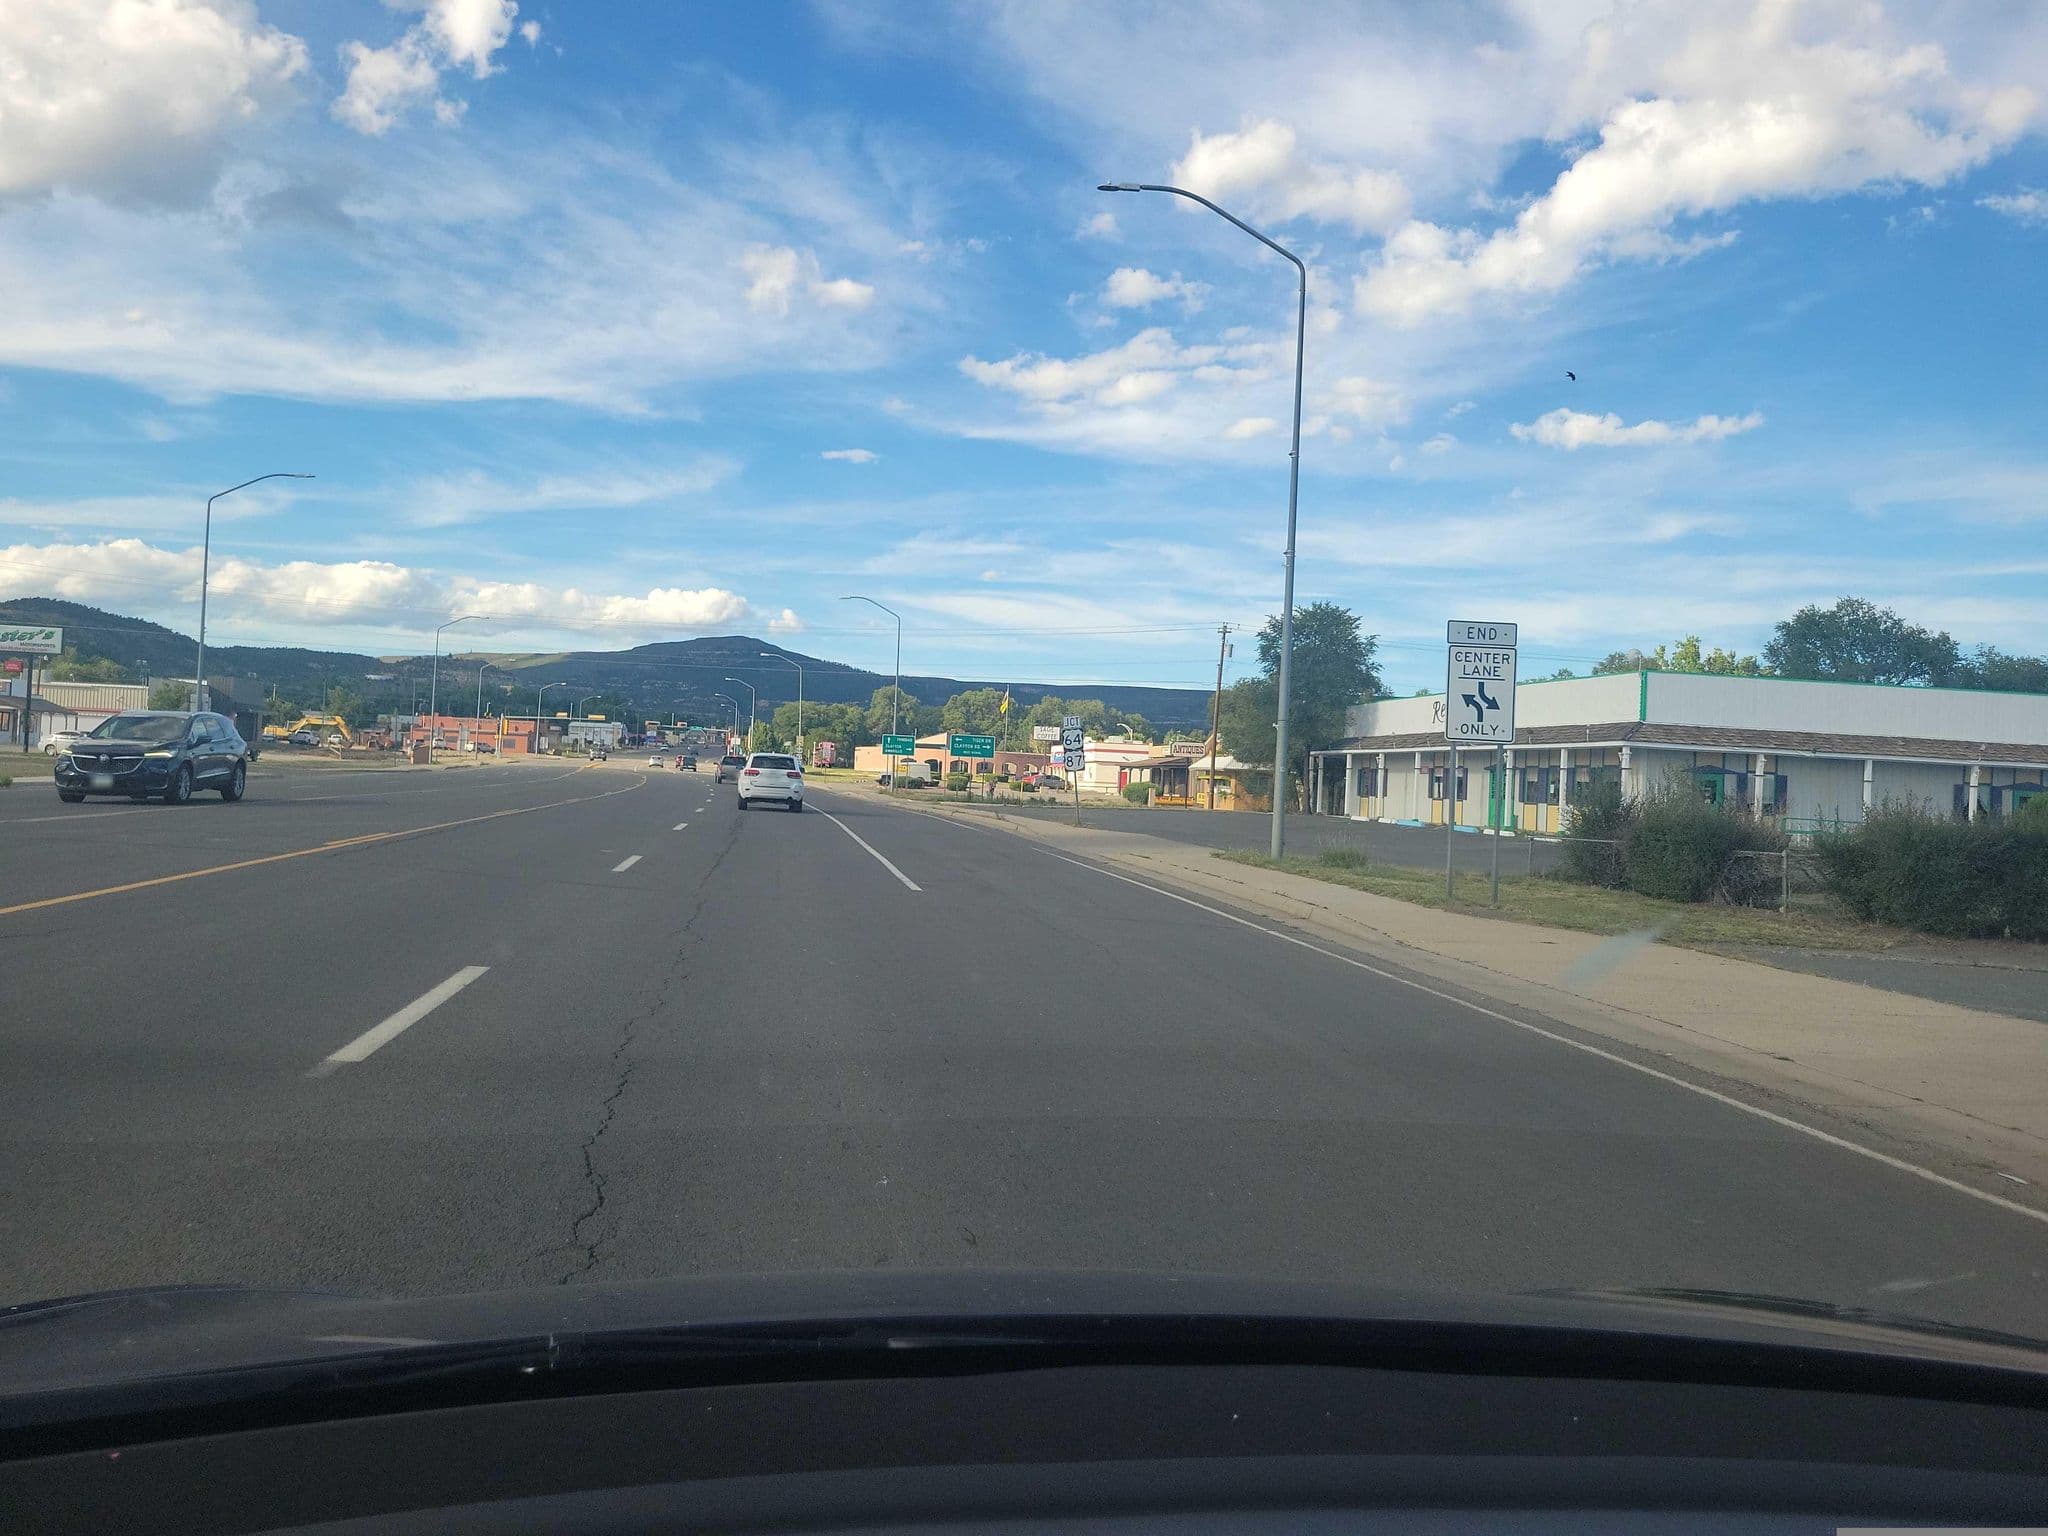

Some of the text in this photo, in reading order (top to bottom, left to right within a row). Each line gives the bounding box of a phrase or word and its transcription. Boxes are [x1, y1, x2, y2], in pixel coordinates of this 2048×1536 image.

[0, 629, 56, 642] ster's
[1467, 627, 1497, 640] END
[1455, 652, 1511, 665] CENTER
[1463, 665, 1501, 677] LANE
[1064, 717, 1080, 727] JCT
[1460, 723, 1499, 736] ONLY
[1065, 734, 1081, 746] 64
[1173, 744, 1205, 755] ANTIQUES
[1066, 755, 1082, 767] 87
